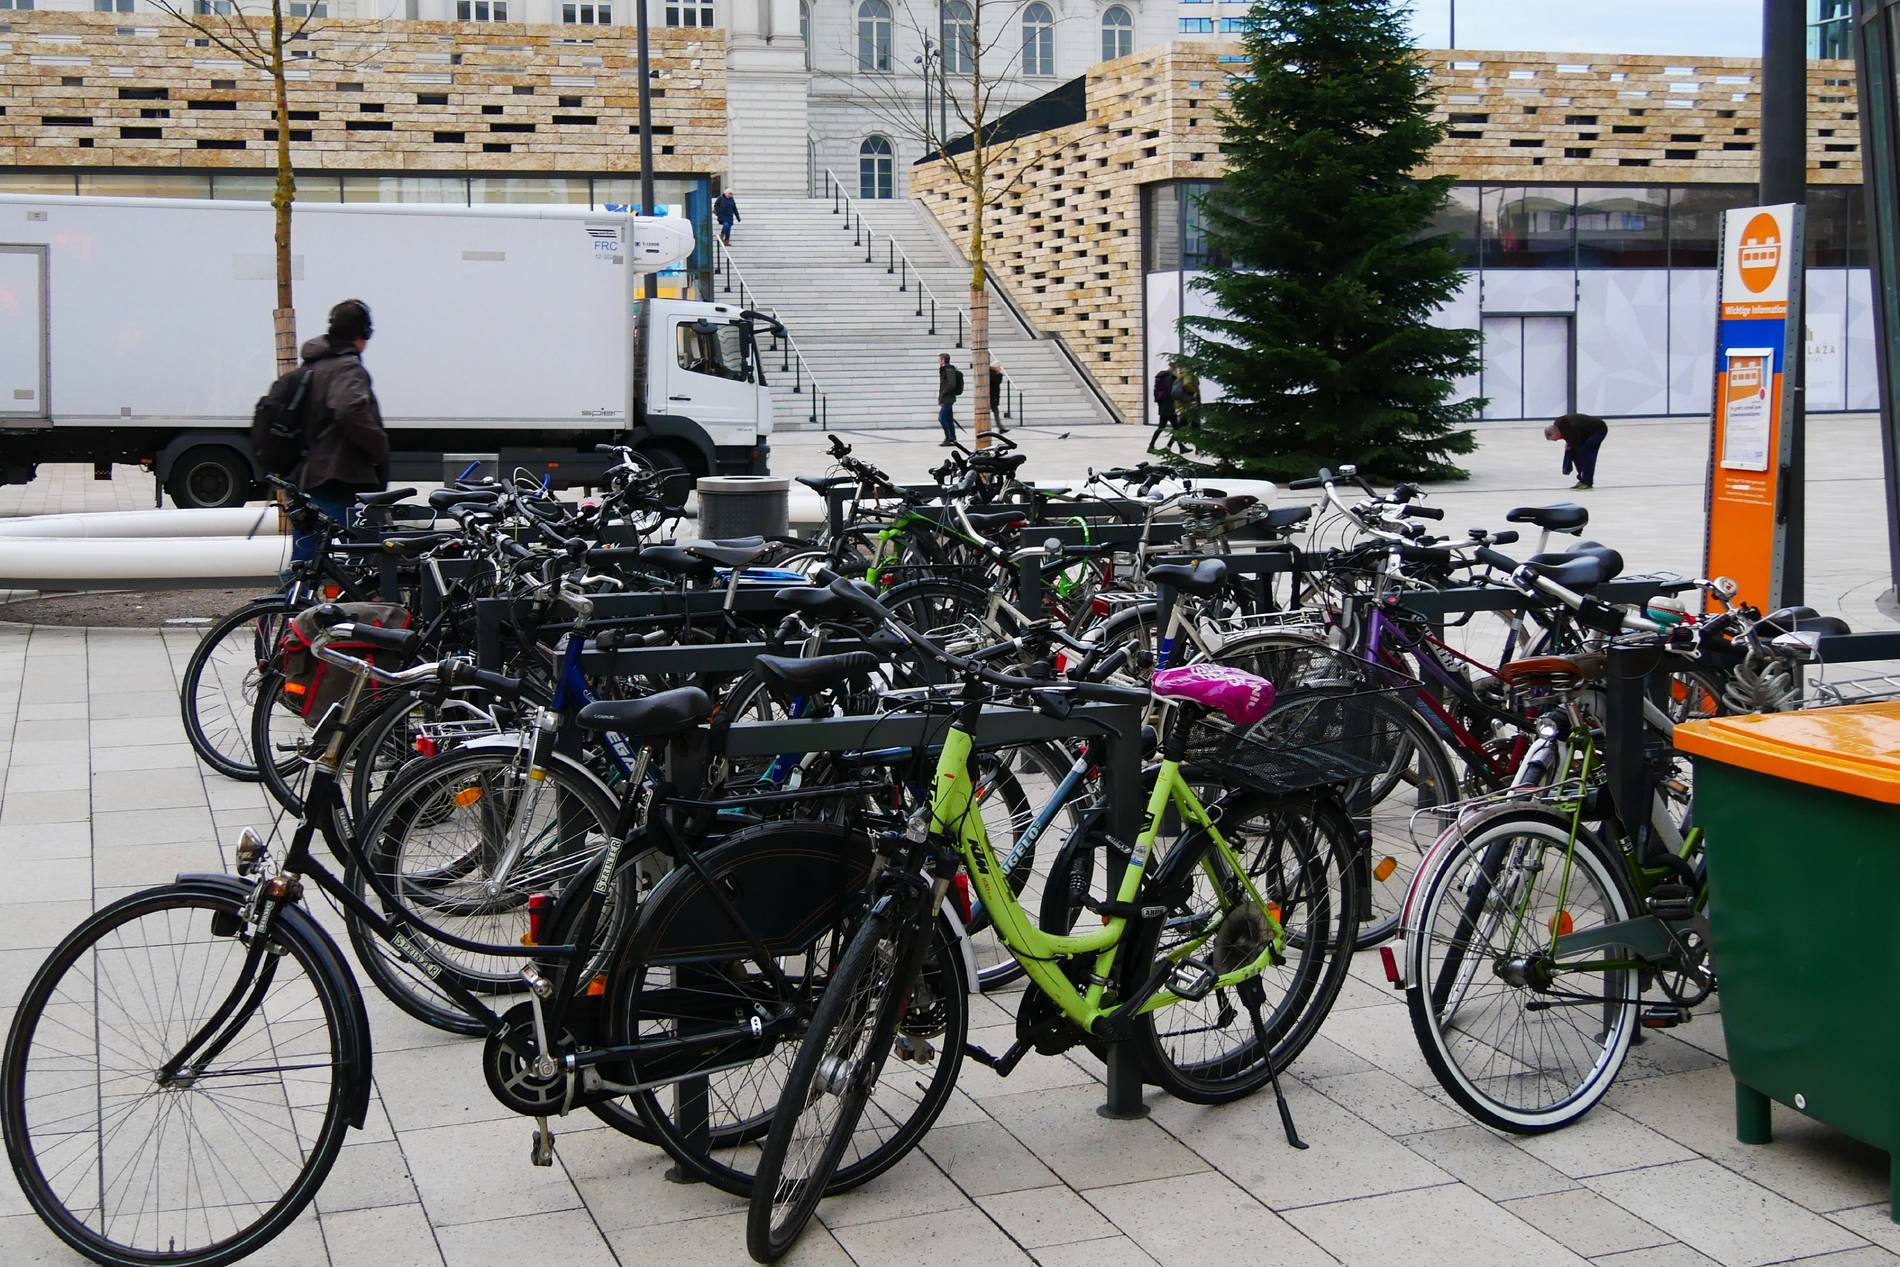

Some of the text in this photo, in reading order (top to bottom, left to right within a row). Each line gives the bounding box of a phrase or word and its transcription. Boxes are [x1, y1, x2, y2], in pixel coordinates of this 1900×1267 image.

[594, 240, 618, 251] FRC
[1725, 303, 1787, 317] Wichtige Information
[1807, 344, 1836, 355] LAZA
[581, 407, 624, 417] spier
[966, 838, 990, 875] KTM
[595, 839, 622, 891] SPRINTER
[394, 936, 438, 976] SPRINTER
